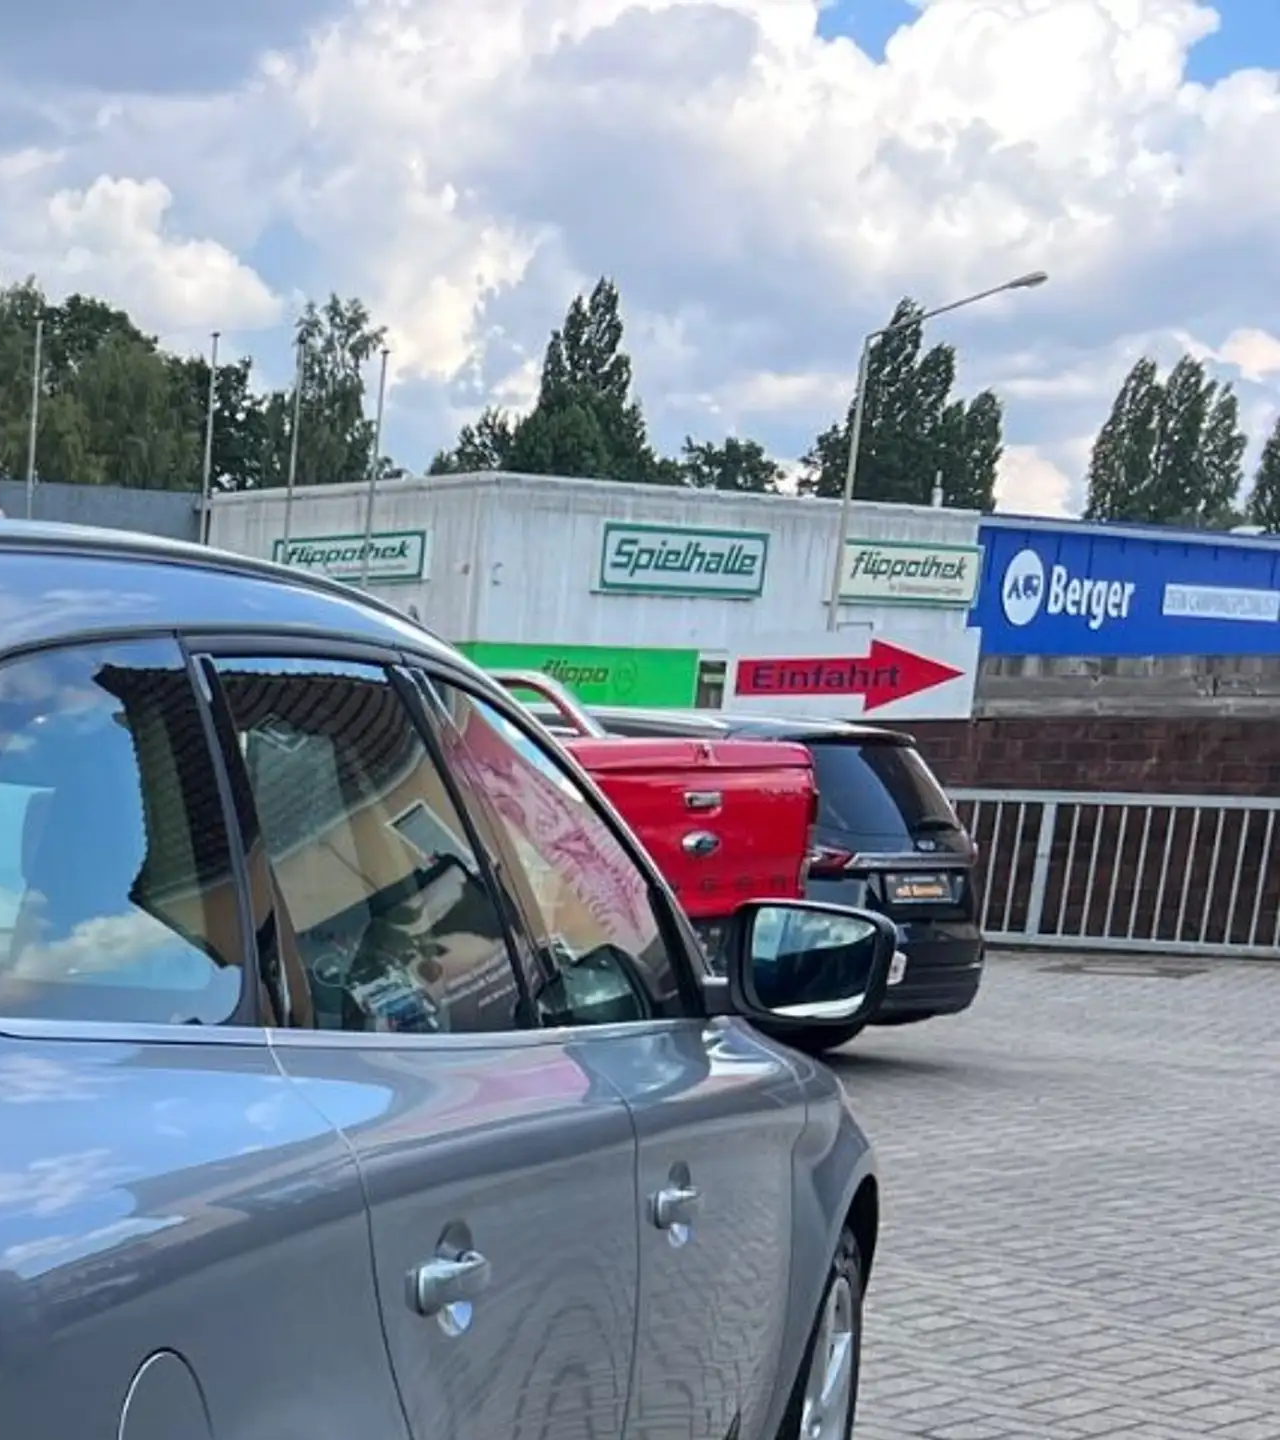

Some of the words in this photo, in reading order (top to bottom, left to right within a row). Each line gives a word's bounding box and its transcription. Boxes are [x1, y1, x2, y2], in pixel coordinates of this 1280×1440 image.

[610, 538, 759, 577] Spielhalle
[850, 551, 967, 580] flippothek
[1047, 565, 1135, 629] Berger
[752, 664, 901, 689] Einfahrt
